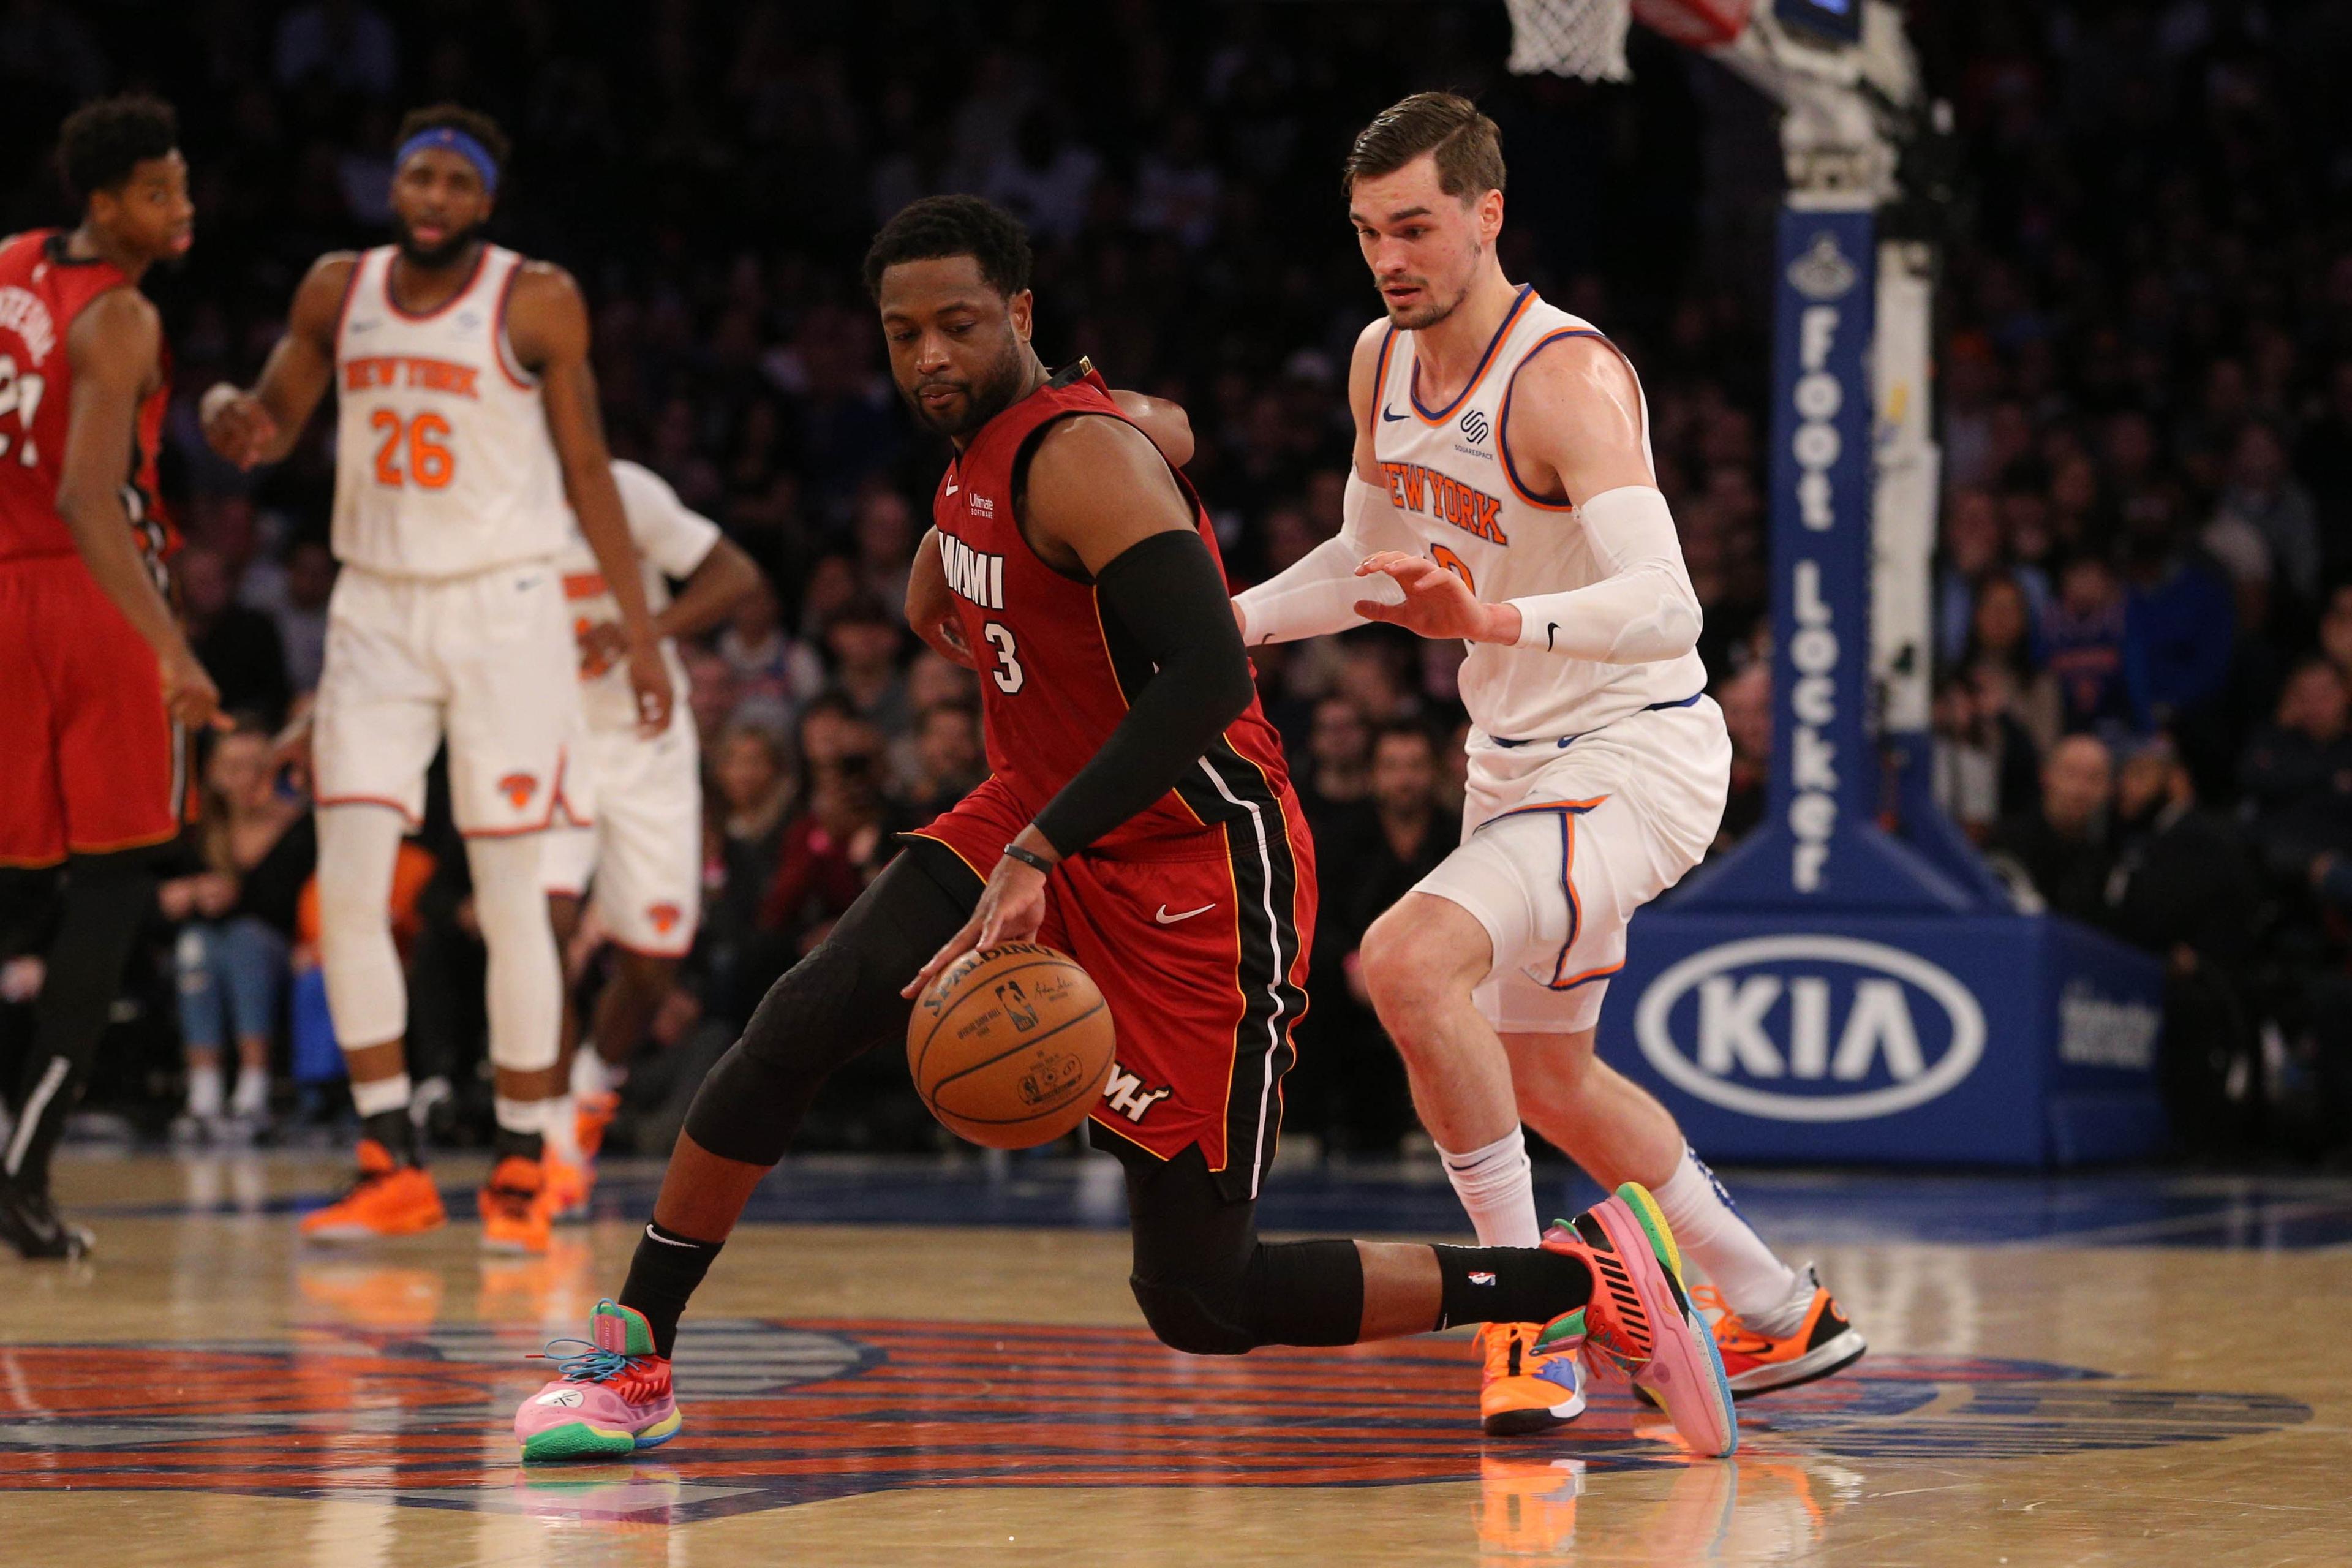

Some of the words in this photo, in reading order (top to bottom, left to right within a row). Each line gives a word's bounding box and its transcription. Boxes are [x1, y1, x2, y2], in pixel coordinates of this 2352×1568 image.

[371, 409, 454, 490] 26
[1792, 306, 1842, 532] Foot
[970, 492, 993, 510] Ultimate
[1427, 469, 1509, 546] YORK
[938, 530, 1005, 610] MIAMI
[983, 620, 1024, 695] 3
[1788, 558, 1839, 894] Locker
[1695, 975, 1927, 1082] KIA
